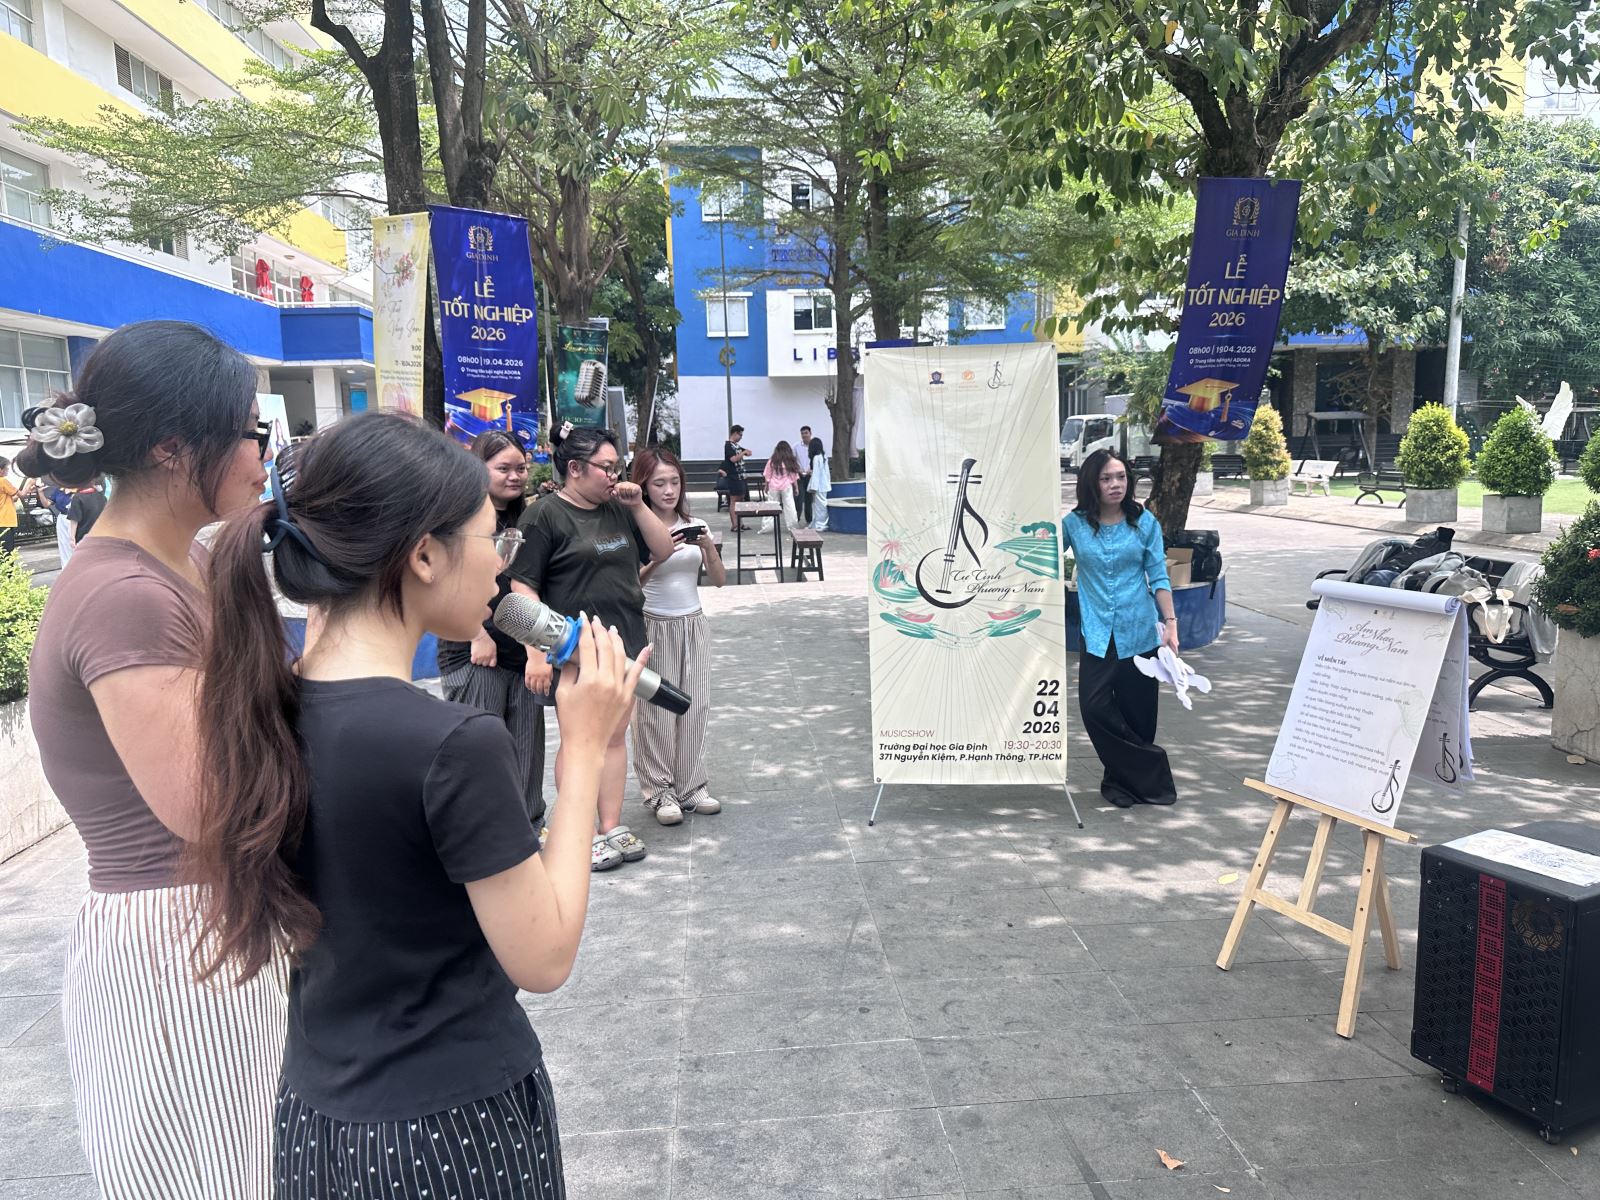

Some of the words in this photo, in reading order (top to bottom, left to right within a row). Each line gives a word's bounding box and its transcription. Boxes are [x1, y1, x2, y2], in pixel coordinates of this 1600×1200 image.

[1224, 253, 1248, 279] LỄ
[474, 275, 495, 298] LỄ
[1188, 281, 1217, 306] TỐT
[1218, 284, 1280, 308] NGHIỆP
[441, 296, 470, 318] TỐT
[474, 303, 533, 326] NGHIỆP
[1209, 311, 1246, 327] 2026
[471, 325, 506, 341] 2026
[1188, 346, 1211, 354] 08h00
[457, 355, 479, 364] 08h00
[483, 358, 523, 367] 19.04.2026
[1012, 581, 1045, 593] Nam
[1376, 640, 1409, 655] Nam
[1037, 679, 1060, 696] 22
[1033, 700, 1059, 717] 04
[880, 729, 936, 738] MUSICSHOW
[1022, 721, 1060, 734] 2026
[879, 743, 911, 752] Trường
[912, 743, 928, 752] Đại
[929, 743, 947, 753] học
[948, 742, 965, 751] Gia
[966, 743, 988, 752] Định
[879, 753, 893, 761] 371
[893, 751, 930, 763] Nguyễn
[931, 752, 958, 763] Kiệm,
[959, 753, 993, 762] P.Hạnh
[995, 753, 1026, 762] Thông,
[1029, 753, 1062, 761] TP.HCM
